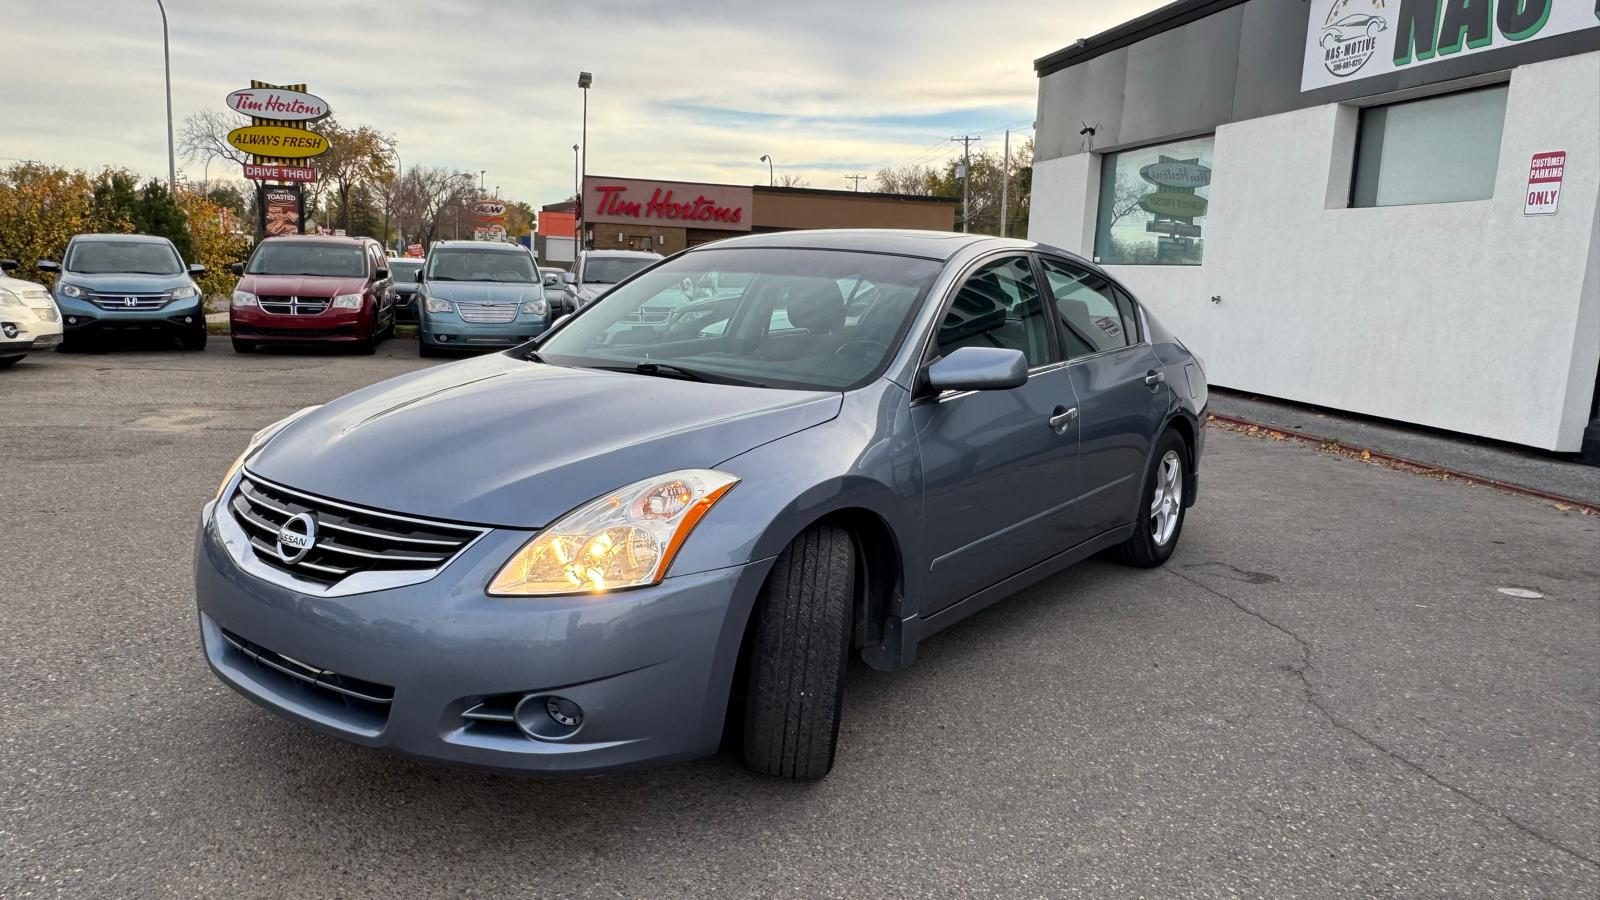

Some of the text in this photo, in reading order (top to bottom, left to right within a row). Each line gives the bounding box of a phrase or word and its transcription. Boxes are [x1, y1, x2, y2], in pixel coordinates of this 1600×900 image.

[1325, 36, 1376, 61] NAS-MOTIVE
[234, 93, 321, 115] Tim Hortons
[234, 133, 322, 149] ALWAYS FRESH
[1532, 157, 1564, 167] CUSTOMER
[246, 167, 312, 179] DRIVE THRU
[1530, 167, 1562, 179] PARKING
[595, 186, 641, 218] Tim
[645, 187, 743, 224] Hortons
[1528, 190, 1557, 206] ONLY
